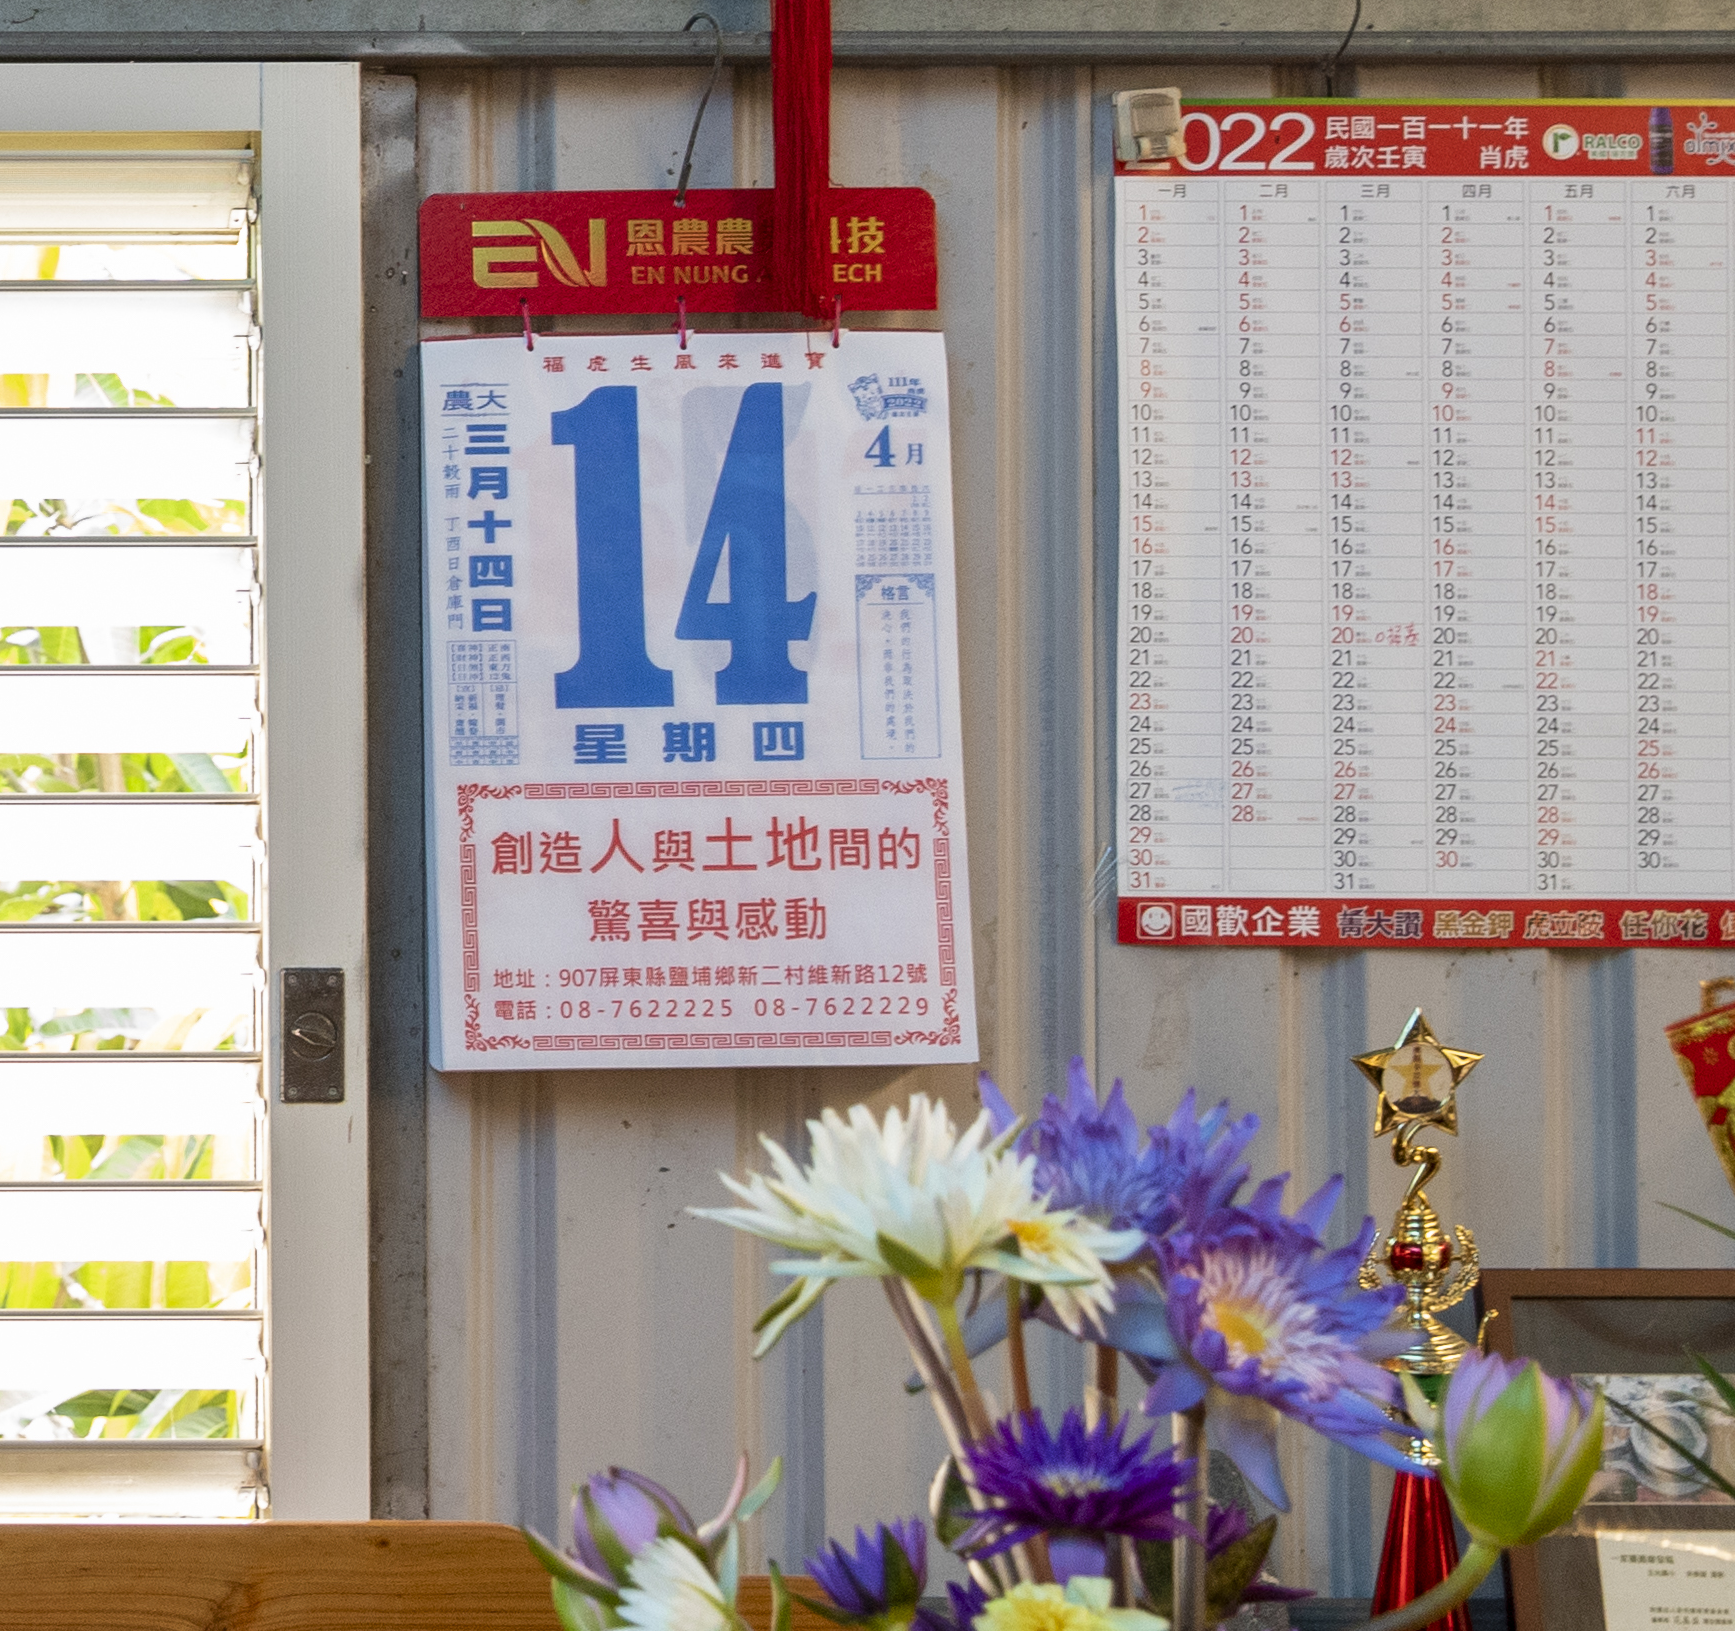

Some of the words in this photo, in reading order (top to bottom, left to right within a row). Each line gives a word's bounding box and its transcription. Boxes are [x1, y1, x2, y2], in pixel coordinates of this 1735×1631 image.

[1325, 116, 1529, 139] 民國一百一十一年
[1122, 111, 1316, 172] 022
[1584, 135, 1642, 149] RALCO
[1325, 146, 1427, 170] 歲次壬寅
[1479, 146, 1529, 170] 肖虎
[1158, 184, 1188, 199] 一月
[1259, 184, 1289, 199] 二月
[1361, 184, 1391, 199] 三月
[1462, 184, 1492, 199] 四月
[1564, 184, 1594, 199] 五月
[1665, 184, 1695, 199] 六月
[1239, 204, 1248, 222] 1
[1442, 204, 1451, 222] 1
[1646, 204, 1655, 223] 1
[1238, 225, 1250, 244] 2
[1440, 226, 1453, 245] 2
[1644, 226, 1658, 245] 2
[1238, 248, 1251, 267] 3
[1441, 248, 1454, 267] 3
[1645, 248, 1658, 268] 3
[631, 266, 665, 285] EN
[673, 265, 749, 285] NUNG
[1238, 270, 1251, 288] 4
[1440, 271, 1453, 288] 4
[1644, 271, 1658, 288] 4
[1239, 292, 1251, 311] 5
[1441, 292, 1454, 311] 5
[1645, 293, 1658, 312] 5
[1238, 315, 1252, 333] 6
[1440, 315, 1454, 334] 6
[1645, 316, 1658, 334] 6
[1239, 336, 1251, 355] 7
[1441, 337, 1453, 355] 7
[1646, 337, 1658, 356] 7
[1238, 359, 1252, 378] 8
[1441, 359, 1454, 378] 8
[1645, 360, 1658, 379] 8
[1238, 381, 1252, 399] 9
[1441, 381, 1455, 400] 9
[1645, 382, 1659, 400] 9
[1229, 403, 1252, 422] 10
[1432, 403, 1455, 423] 10
[1636, 404, 1659, 423] 10
[1230, 426, 1249, 444] 11
[1636, 427, 1655, 445] 11
[1230, 447, 1252, 466] 12
[1636, 449, 1658, 468] 12
[1230, 470, 1252, 489] 13
[1636, 471, 1658, 490] 13
[1231, 493, 1252, 510] 14
[1636, 494, 1658, 511] 14
[464, 423, 514, 632] 三月十四日
[1231, 514, 1253, 533] 15
[1636, 516, 1658, 535] 15
[550, 381, 819, 710] 14
[1231, 537, 1253, 555] 16
[1636, 538, 1659, 557] 16
[1231, 559, 1253, 577] 17
[1636, 560, 1658, 578] 17
[881, 585, 910, 600] 格言
[1231, 581, 1254, 600] 18
[1637, 582, 1659, 602] 18
[1231, 603, 1254, 621] 19
[1637, 604, 1660, 623] 19
[1230, 625, 1254, 645] 20
[1636, 627, 1660, 646] 20
[1230, 648, 1251, 667] 21
[1636, 649, 1657, 668] 21
[1230, 670, 1254, 689] 22
[1637, 672, 1660, 691] 22
[1230, 692, 1254, 711] 23
[1637, 694, 1660, 713] 23
[1230, 715, 1254, 733] 24
[1637, 716, 1660, 735] 24
[572, 720, 807, 766] 星期四
[1230, 737, 1255, 756] 25
[1636, 738, 1661, 758] 25
[1231, 759, 1255, 778] 26
[1637, 761, 1661, 780] 26
[1231, 782, 1254, 801] 27
[1636, 783, 1660, 802] 27
[1231, 804, 1255, 823] 28
[1636, 806, 1661, 825] 28
[490, 813, 923, 878] 創造人與土地間的
[1637, 828, 1661, 847] 29
[1637, 850, 1662, 870] 30
[586, 894, 829, 946] 驚喜與感動
[1181, 905, 1321, 938] 國歡企業
[1432, 909, 1514, 939] 黑金鉀
[1619, 908, 1709, 940] 任你花
[754, 996, 929, 1018] 08-7622229
